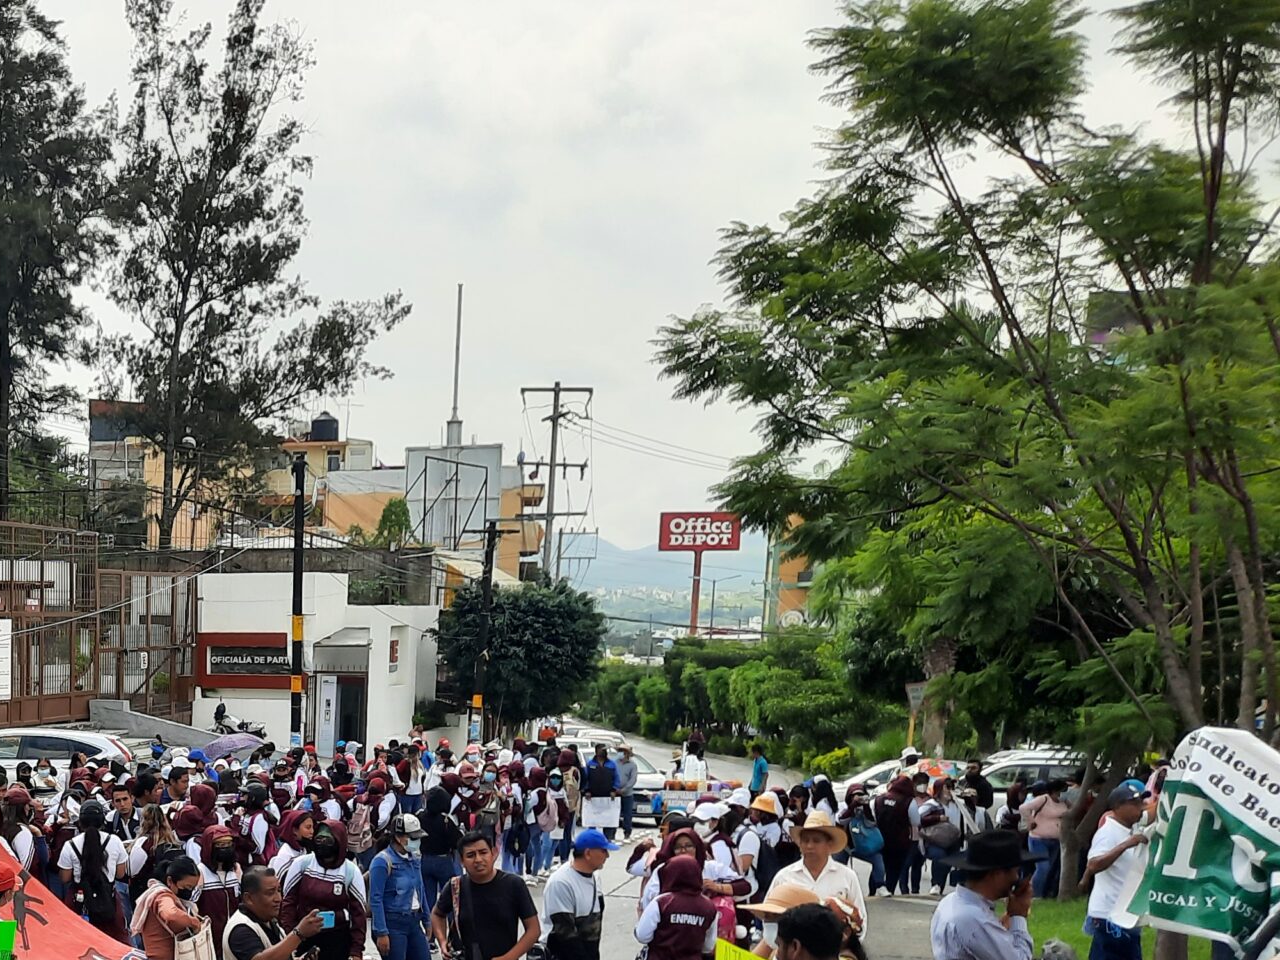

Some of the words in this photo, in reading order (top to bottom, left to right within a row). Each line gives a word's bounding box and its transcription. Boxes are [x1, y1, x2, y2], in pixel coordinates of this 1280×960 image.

[669, 518, 733, 534] Office
[669, 534, 732, 546] DEPOT
[211, 654, 253, 664] OFICIALÍA
[254, 656, 266, 664] DE
[267, 656, 289, 664] PART
[1208, 772, 1236, 797] de
